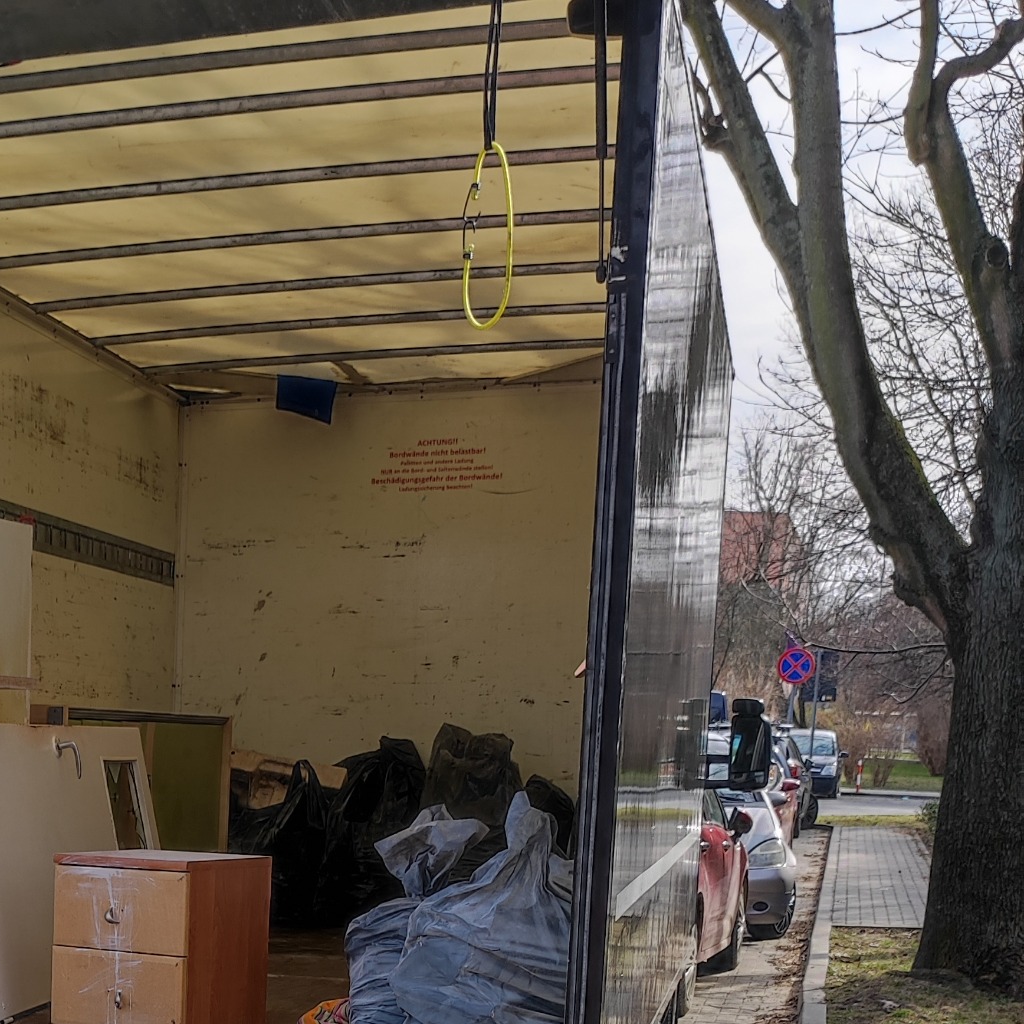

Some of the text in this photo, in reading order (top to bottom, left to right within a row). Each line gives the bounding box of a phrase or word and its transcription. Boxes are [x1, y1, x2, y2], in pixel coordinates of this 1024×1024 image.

[417, 439, 458, 447] ACHTUNG!!
[389, 448, 486, 459] Bordwände nicht belastbar!
[371, 475, 444, 485] Beschädigungsgefahr
[445, 474, 458, 482] der
